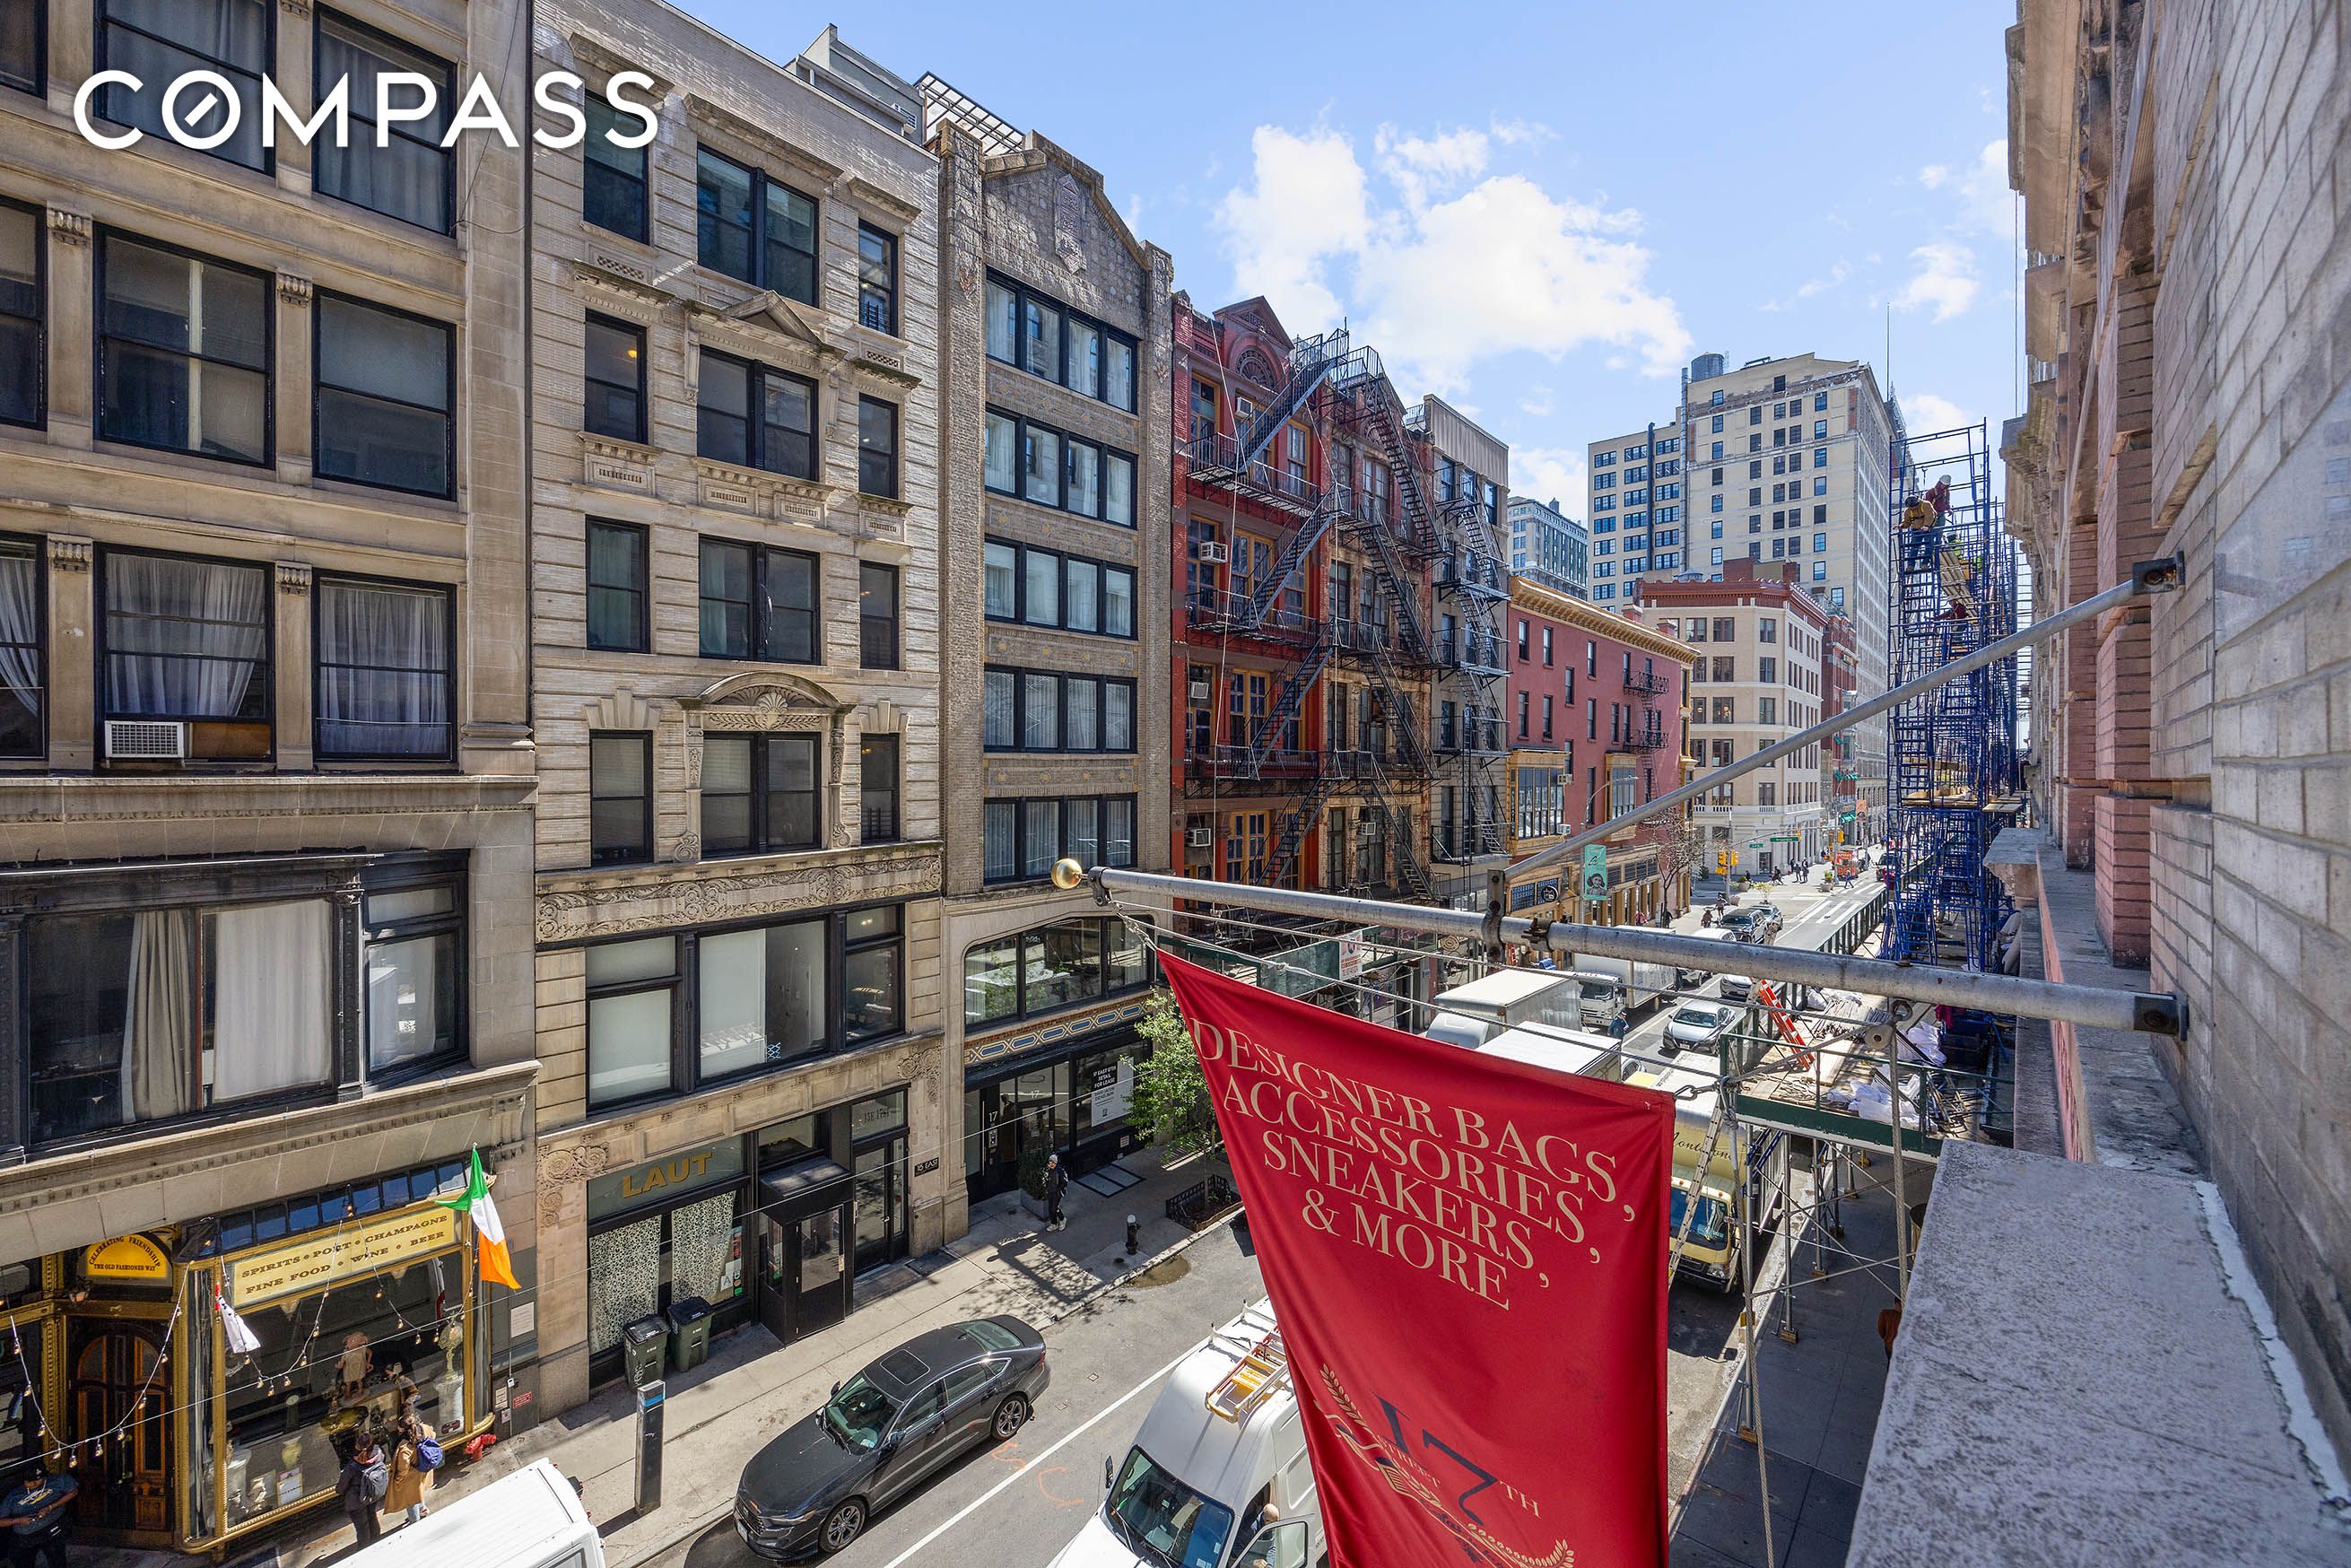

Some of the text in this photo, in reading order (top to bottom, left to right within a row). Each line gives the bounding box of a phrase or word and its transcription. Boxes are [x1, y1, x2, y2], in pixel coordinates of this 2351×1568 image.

[1102, 1077, 1115, 1085] LEASE
[1189, 1017, 1442, 1138] DESIGNER
[988, 1111, 998, 1122] 17
[623, 1151, 713, 1199] LAUT
[917, 1163, 924, 1172] 15
[925, 1158, 938, 1169] EAST
[89, 1236, 161, 1267] CELEBRATING FRIENDSHIP
[242, 1215, 448, 1278] SPIRITS PORT CHAMPAGNE
[246, 1277, 283, 1294] FINE
[290, 1264, 331, 1282] FOOD
[410, 1232, 445, 1247] BEER
[1302, 1189, 1510, 1311] & MORE
